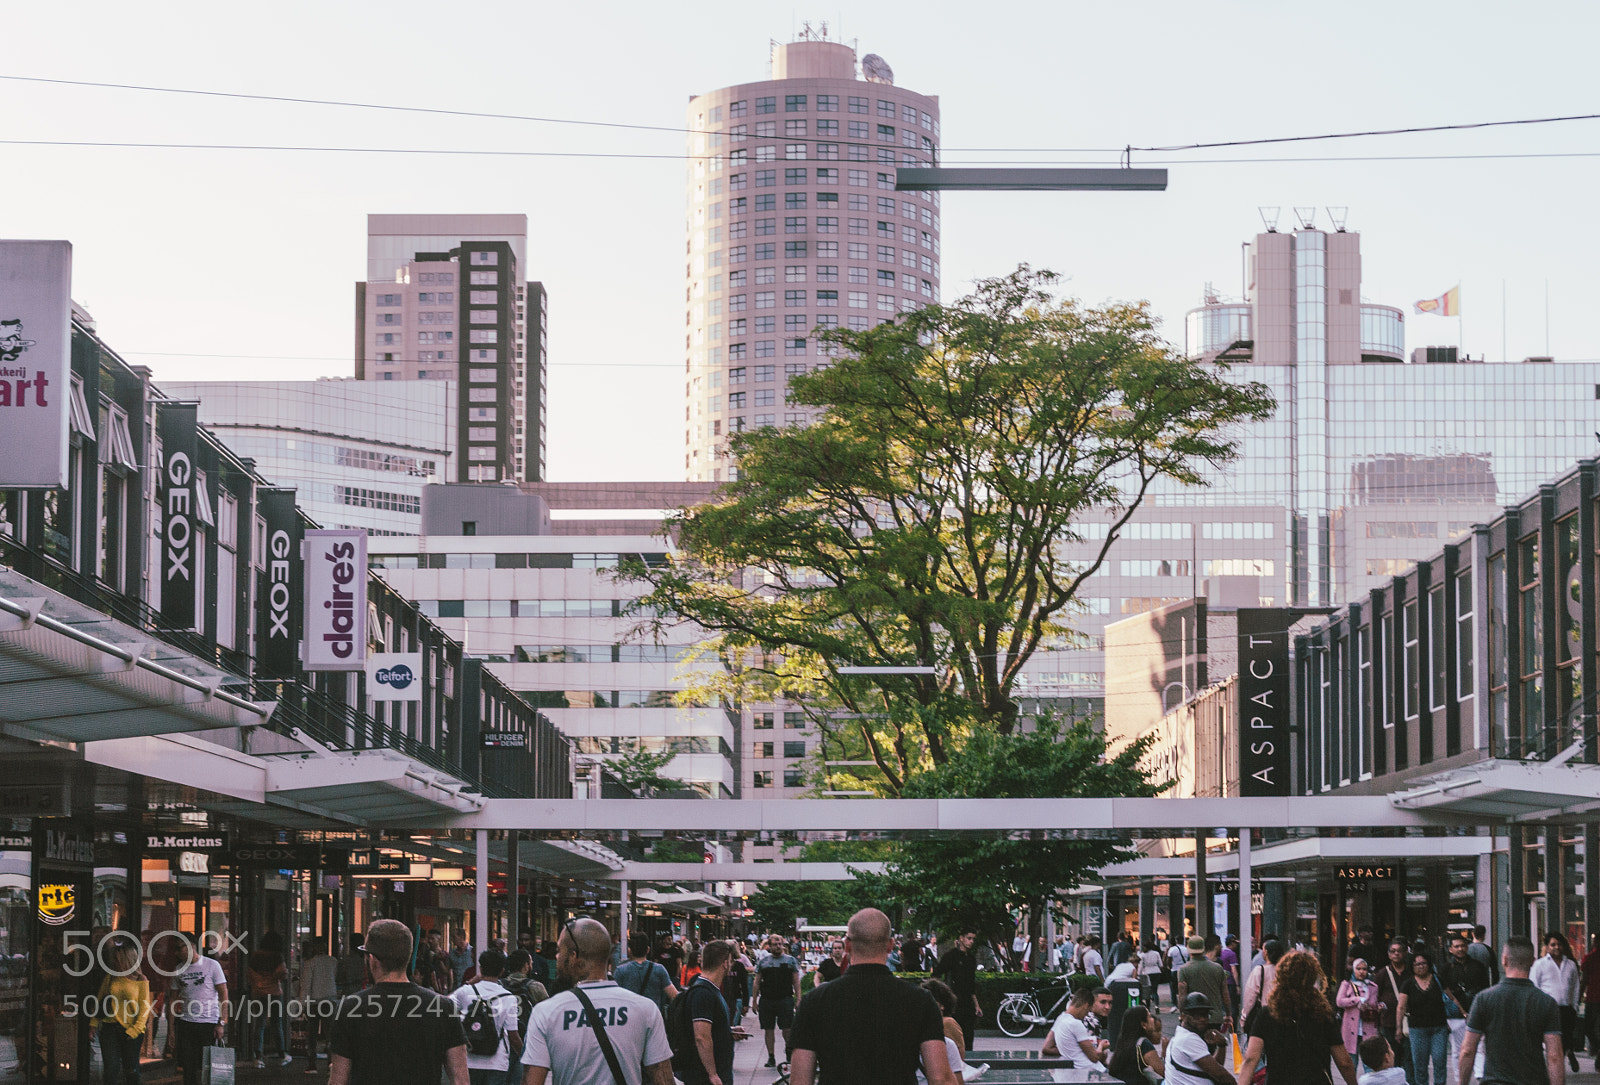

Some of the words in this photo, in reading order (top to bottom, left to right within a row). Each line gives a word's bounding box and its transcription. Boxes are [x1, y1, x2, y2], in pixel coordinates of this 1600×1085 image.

[168, 451, 191, 581] GEOX
[270, 529, 290, 639] GEOX
[323, 541, 355, 659] claire's
[1249, 635, 1275, 786] ASPACT
[236, 850, 297, 860] GEOX
[1219, 883, 1262, 891] ASPCT
[1338, 868, 1392, 878] ASPACT
[563, 1006, 628, 1031] PARIS
